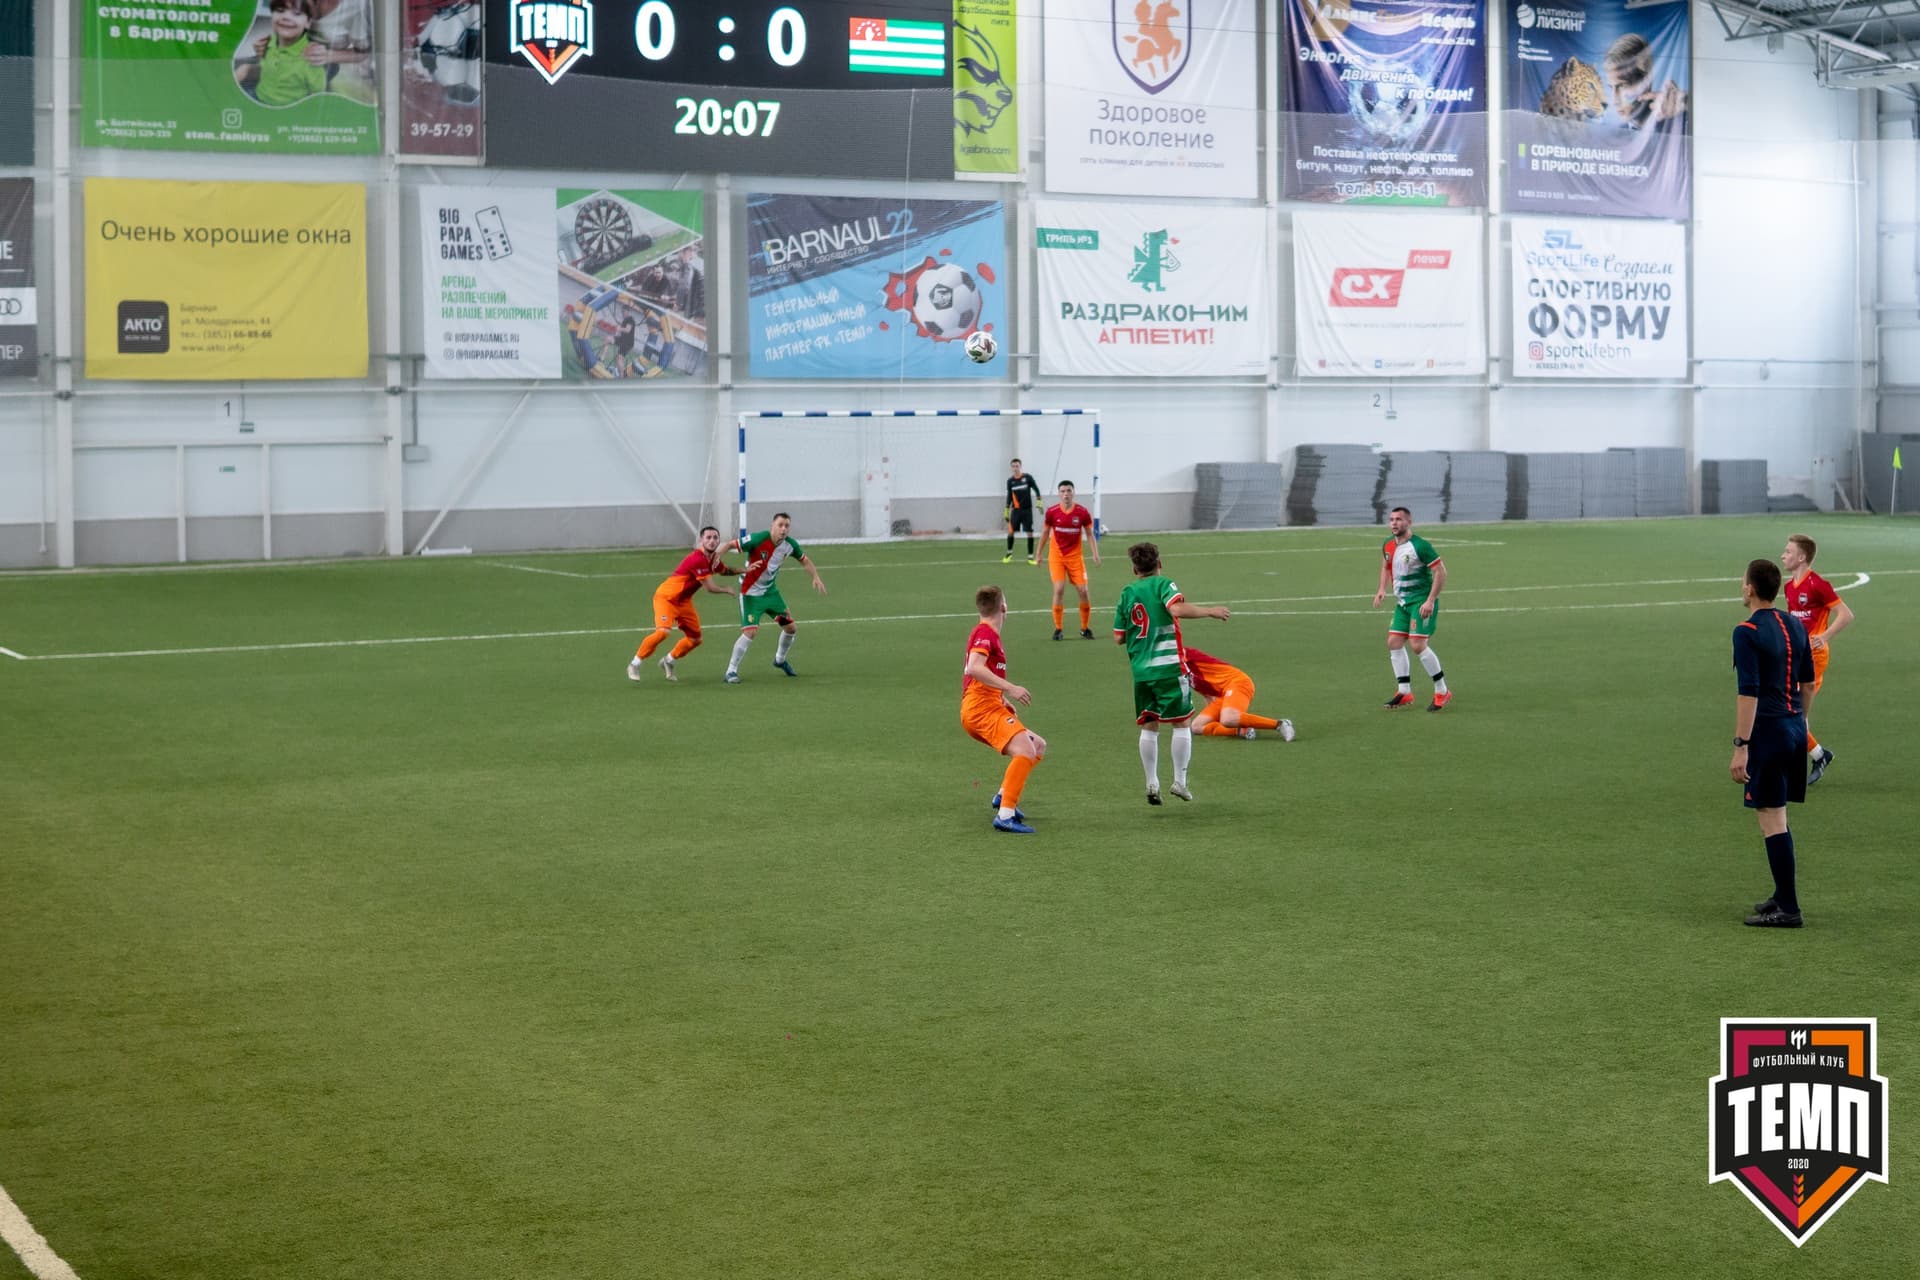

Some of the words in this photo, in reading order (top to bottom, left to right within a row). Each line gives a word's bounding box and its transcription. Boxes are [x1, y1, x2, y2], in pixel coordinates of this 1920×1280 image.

[98, 7, 231, 24] стоматология
[1536, 8, 1586, 18] БАЛТИЙСКИЙ
[519, 3, 585, 44] ТЕМП
[1536, 16, 1585, 32] ЛИЗИНГ
[110, 26, 121, 38] в
[128, 25, 219, 43] Барнауле
[635, 1, 676, 60] 0
[767, 7, 807, 66] 0
[1408, 88, 1474, 101] победам!
[674, 98, 780, 137] 20:07
[1097, 99, 1207, 125] Здоровое
[411, 123, 474, 137] 39-57-29
[1089, 128, 1215, 149] поколение
[1313, 145, 1364, 159] Поставка
[1531, 144, 1622, 161] СОРЕВНОВАНИЕ
[1296, 159, 1332, 173] битум,
[1334, 162, 1367, 175] мазут,
[1431, 166, 1474, 177] топливо
[1531, 159, 1539, 170] В
[1542, 160, 1596, 175] ПРИРОДЕ
[1599, 163, 1649, 178] БИЗНЕСА
[1375, 182, 1436, 198] 39-51-41
[439, 208, 460, 225] BIG
[100, 219, 176, 242] Очень
[184, 227, 289, 247] хорошие
[296, 227, 352, 244] окна
[440, 226, 472, 242] PAPA
[441, 244, 483, 260] GAMES
[1413, 254, 1445, 265] news
[441, 275, 477, 290] АРЕНДА
[1528, 278, 1671, 301] СПОРТИВНУЮ
[441, 290, 507, 304] РАЗВЛЕЧЕНИЙ
[764, 286, 840, 317] ГЕНЕРАЛЬНЫЙ
[441, 307, 454, 319] НА
[457, 307, 483, 319] ВАШЕ
[485, 308, 549, 320] МЕРОПРИЯТИЕ
[1061, 302, 1248, 324] РАЗДРАКОНИМ
[124, 318, 162, 332] АКТО
[765, 303, 867, 341] ИНФОРМАЦИОННЫЙ
[1528, 303, 1671, 341] ФОРМУ
[1098, 328, 1214, 344] АППЕТИТ!
[764, 339, 812, 362] ПАРТНЕР
[814, 335, 831, 350] ФК
[223, 400, 232, 417] 1
[1373, 394, 1381, 408] 2
[1130, 603, 1150, 639] 9
